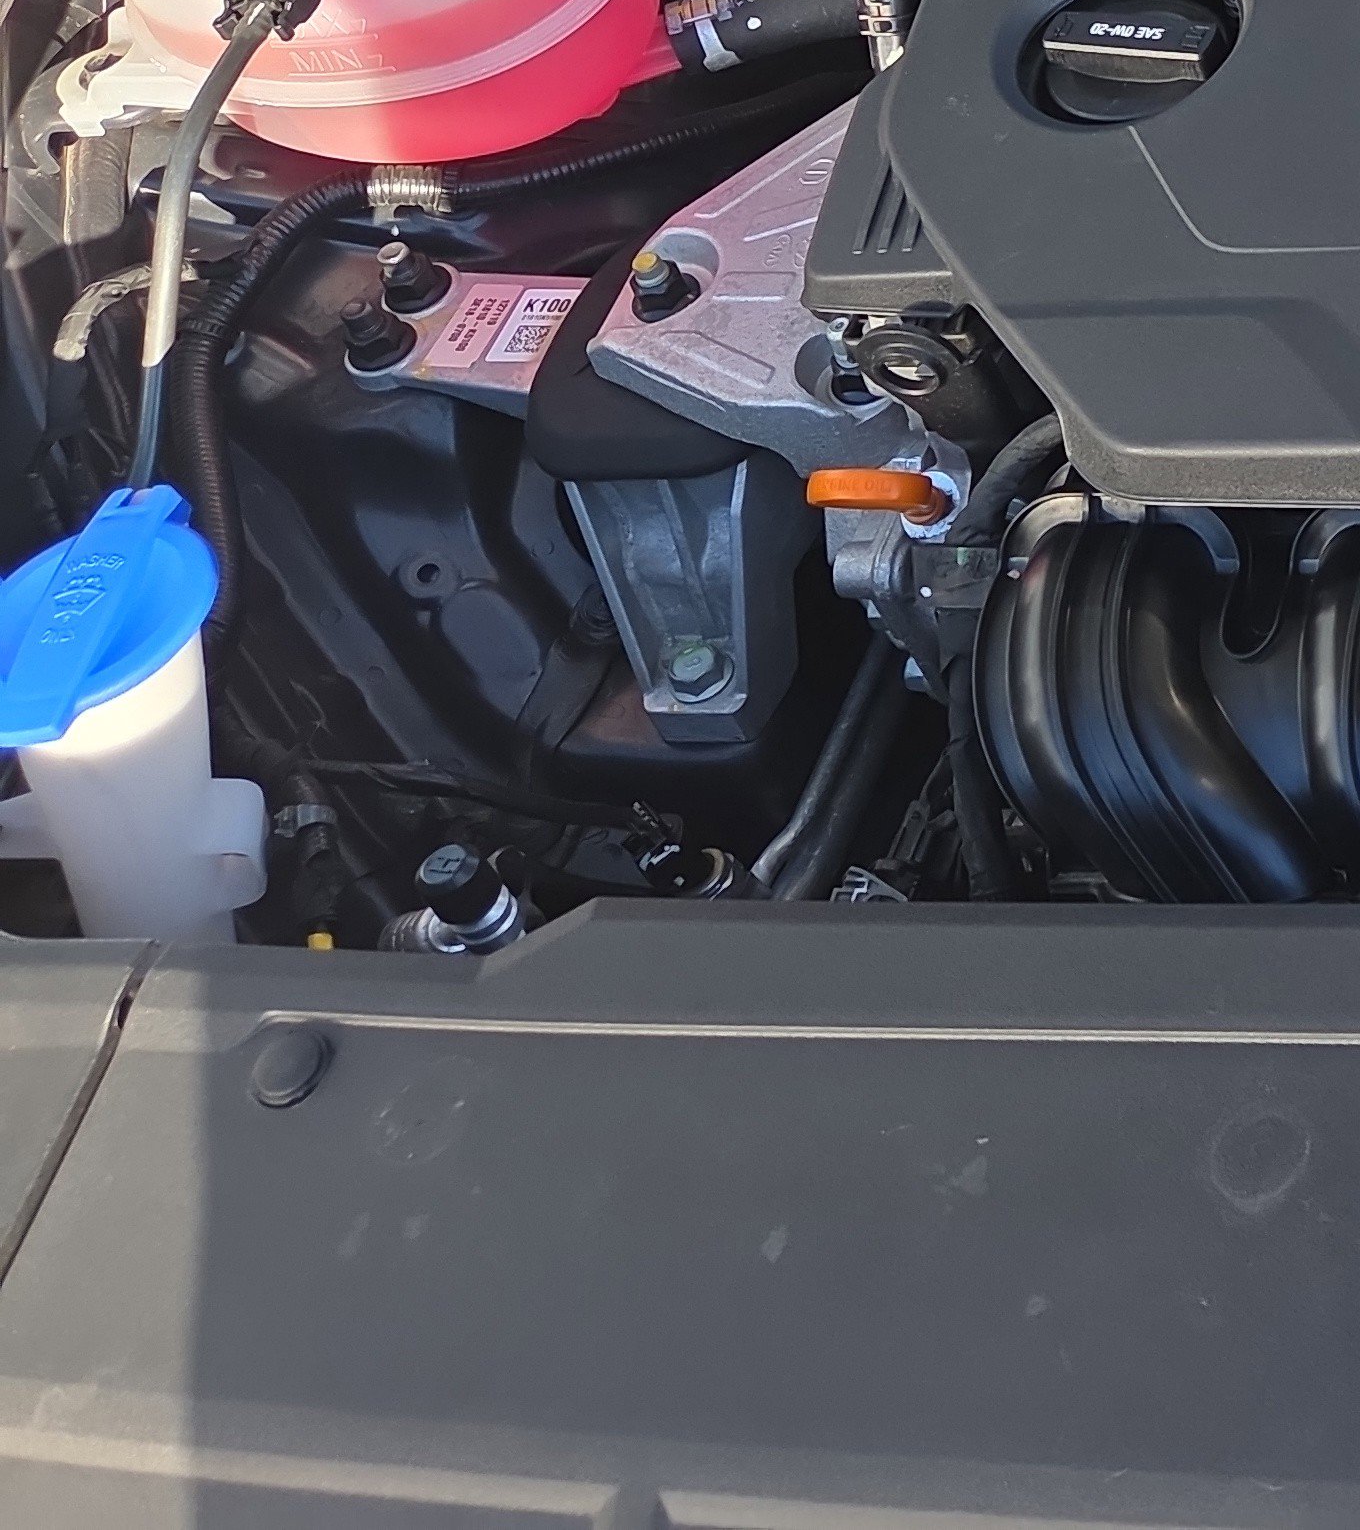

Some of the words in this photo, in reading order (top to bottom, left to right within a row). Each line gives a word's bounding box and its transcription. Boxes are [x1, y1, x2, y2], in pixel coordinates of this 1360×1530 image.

[1088, 22, 1136, 38] 0W-20
[1136, 25, 1166, 40] SAE
[522, 298, 573, 314] K100
